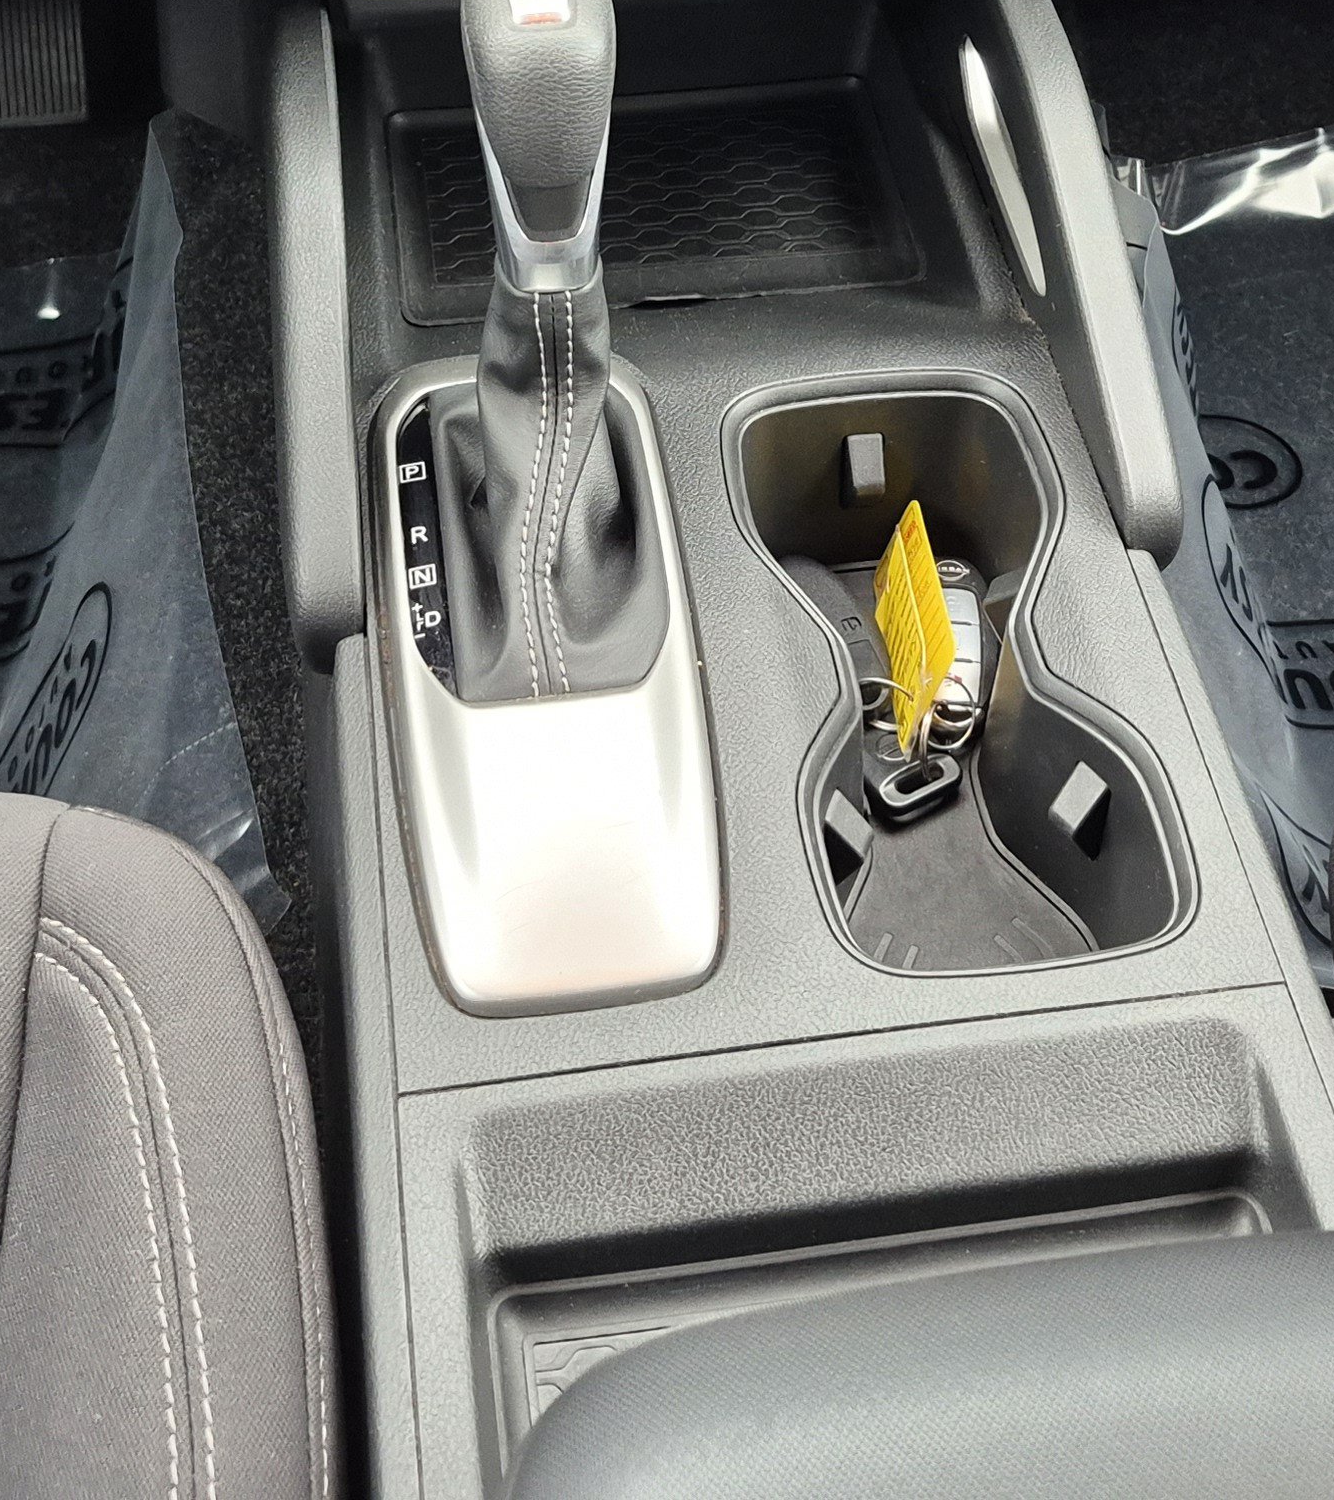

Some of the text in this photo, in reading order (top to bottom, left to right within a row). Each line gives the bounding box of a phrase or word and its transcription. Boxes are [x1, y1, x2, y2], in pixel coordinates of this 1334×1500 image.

[405, 466, 419, 479] P
[410, 526, 428, 544] R
[416, 569, 431, 583] N
[425, 611, 441, 628] D
